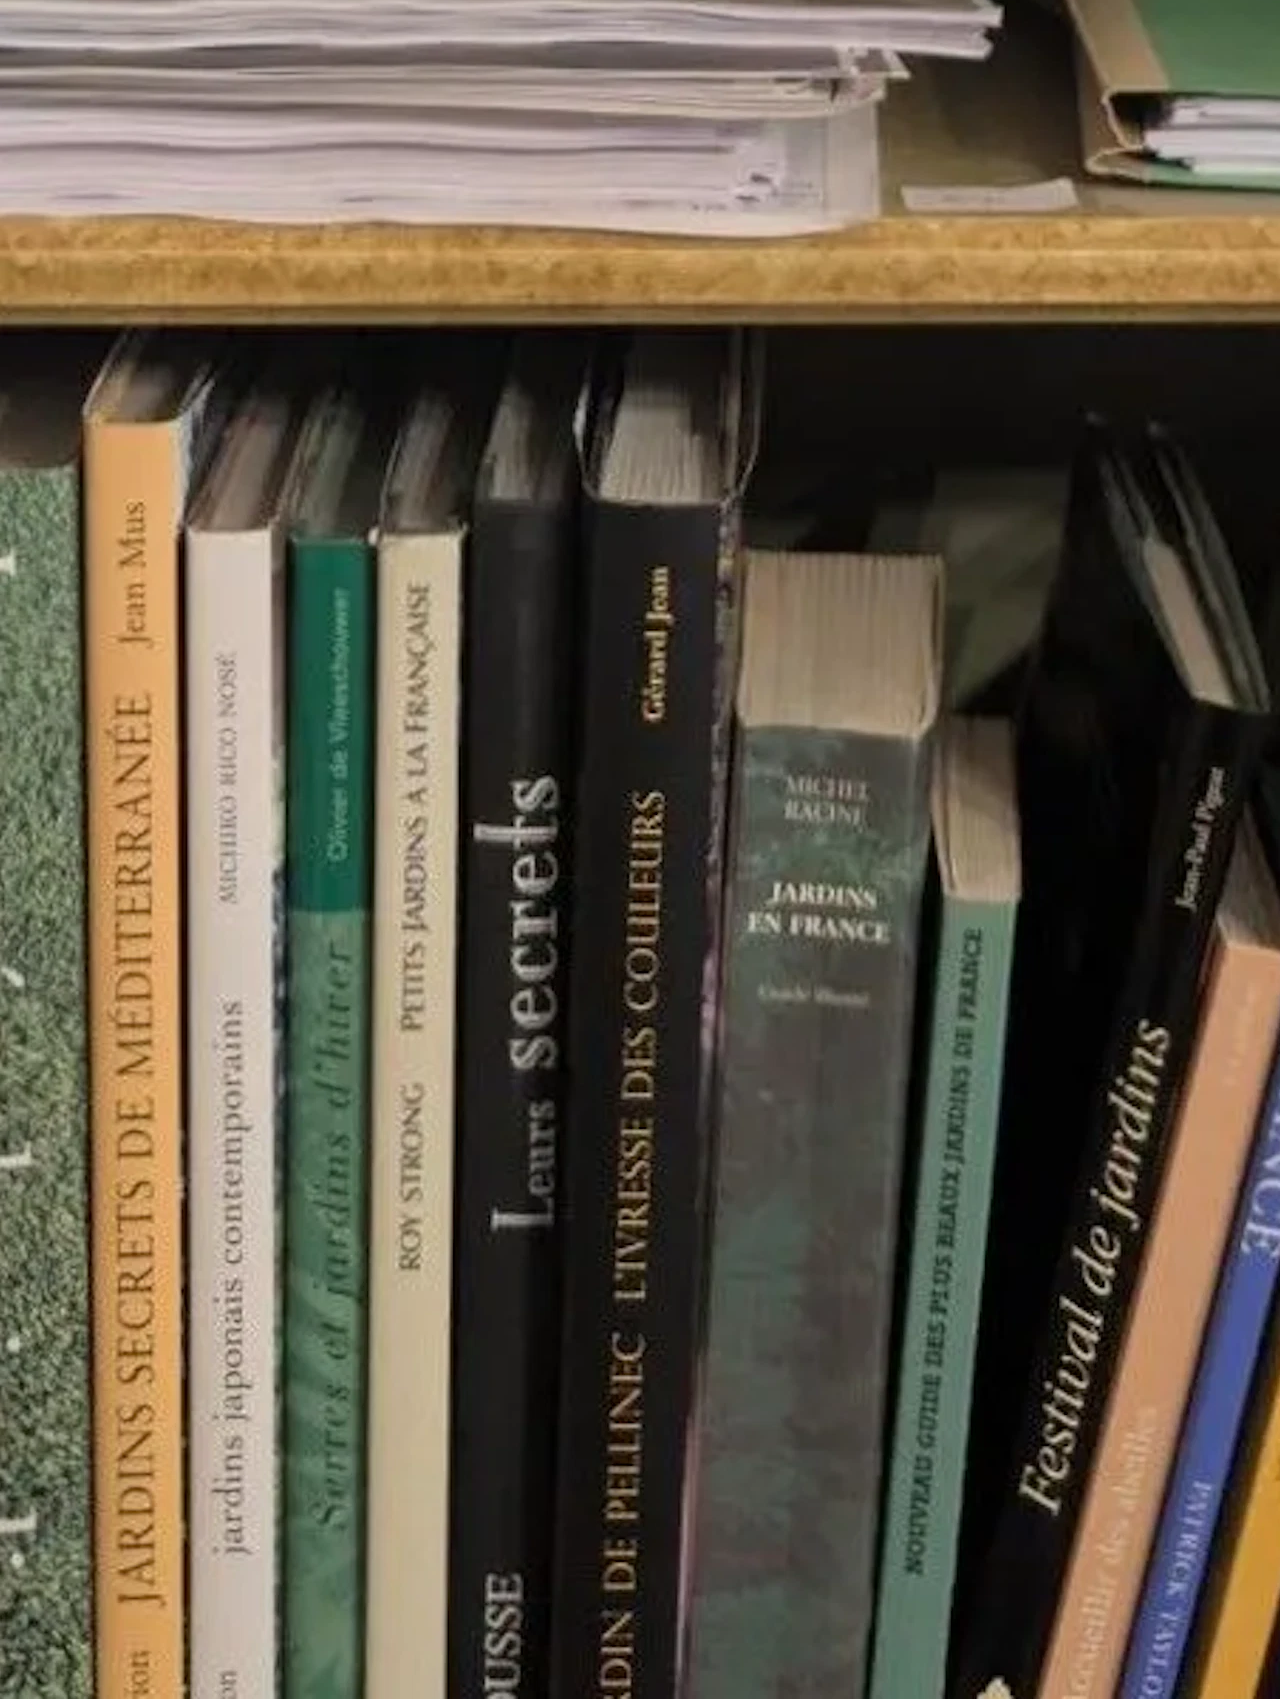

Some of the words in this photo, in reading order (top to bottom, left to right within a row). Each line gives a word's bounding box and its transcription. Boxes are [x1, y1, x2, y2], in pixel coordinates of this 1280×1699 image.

[119, 501, 147, 568] Mus
[117, 581, 153, 648] Jean
[644, 565, 673, 622] Jean
[641, 629, 670, 722] Gérard
[105, 693, 155, 1077] MÉDITERRANÉE
[622, 789, 665, 1011] COULEURS
[747, 913, 781, 935] EN
[790, 916, 890, 944] FRANCE
[769, 882, 878, 910] JARDINS
[623, 1028, 656, 1101] DES
[115, 1103, 154, 1159] DE
[221, 1002, 249, 1265] contemporains
[1087, 1017, 1174, 1231] jardins
[614, 1117, 654, 1301] L'IVRESSE
[1081, 1225, 1121, 1296] de
[115, 1179, 155, 1385] SECRETS
[212, 1279, 251, 1423] japonais
[1018, 1294, 1106, 1515] Festival
[608, 1332, 644, 1520] PELLINEC
[116, 1405, 165, 1609] JARDINS
[212, 1438, 252, 1555] jardins
[603, 1538, 636, 1591] DE
